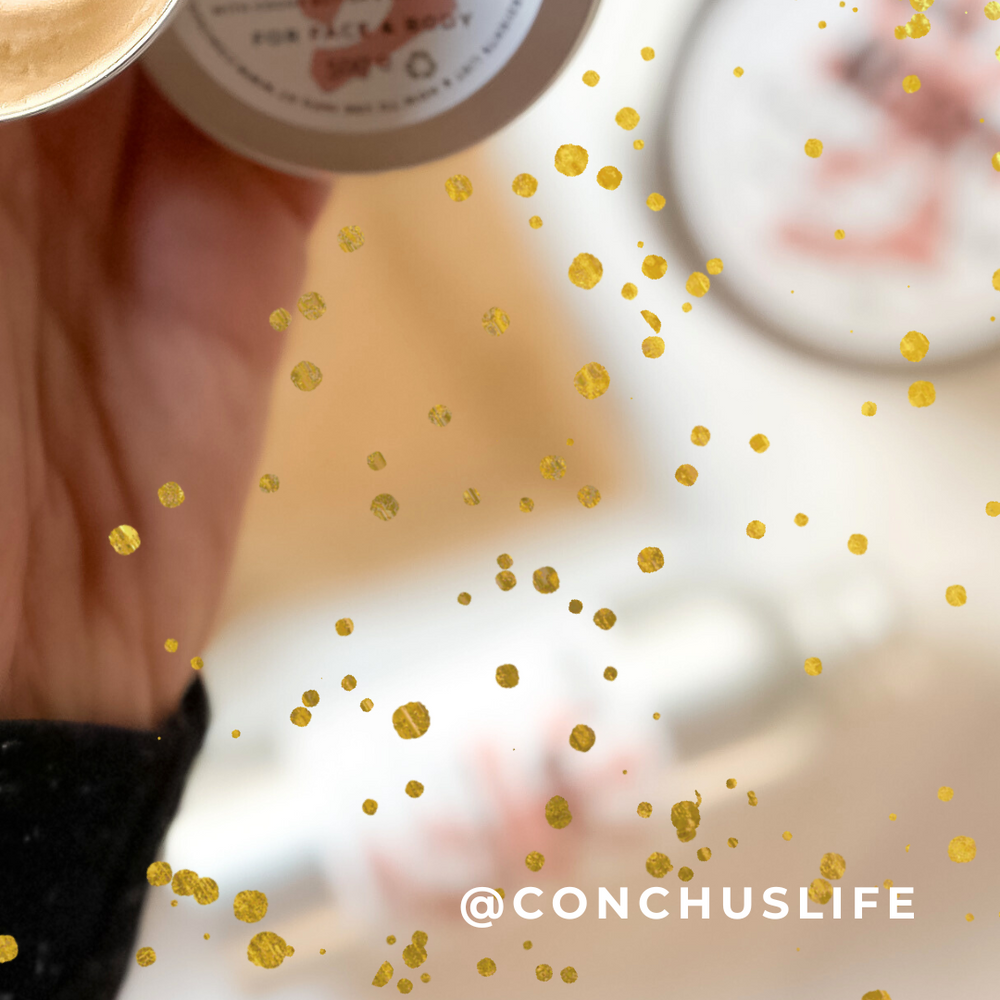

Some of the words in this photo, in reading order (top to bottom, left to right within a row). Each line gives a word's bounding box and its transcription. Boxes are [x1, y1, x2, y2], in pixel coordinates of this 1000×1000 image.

[252, 28, 299, 46] FOR
[308, 22, 368, 42] FACE
[405, 12, 474, 32] BODY
